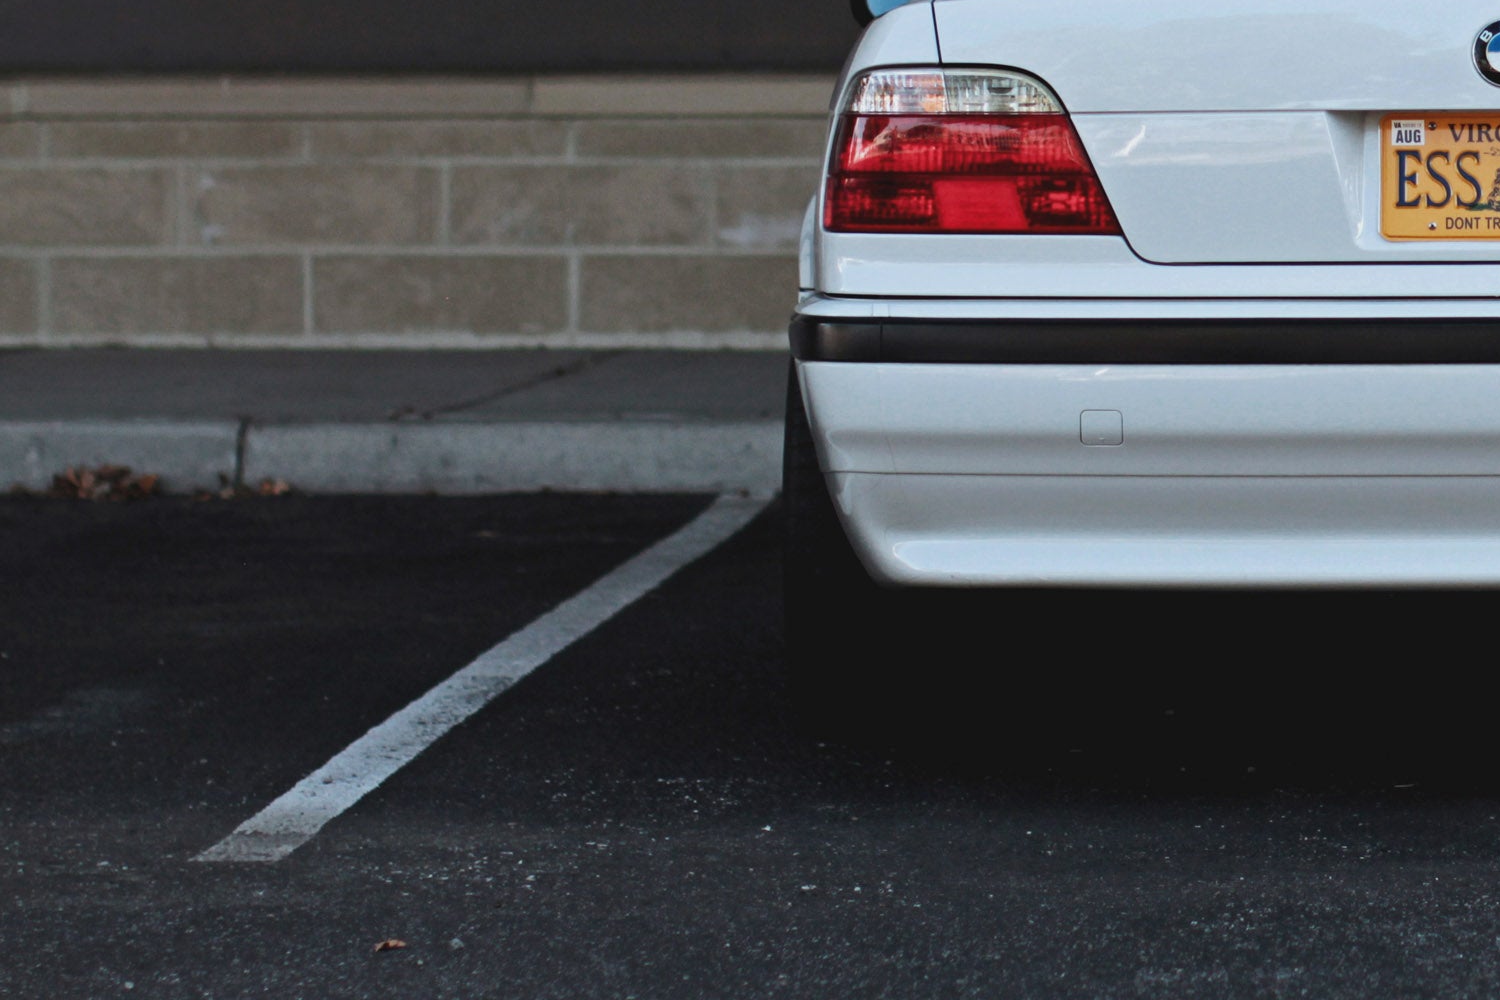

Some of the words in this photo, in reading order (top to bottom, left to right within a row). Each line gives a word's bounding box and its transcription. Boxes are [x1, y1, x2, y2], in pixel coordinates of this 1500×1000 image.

[1396, 129, 1421, 143] AUG
[1395, 149, 1483, 208] ESS
[1445, 217, 1482, 230] DONT
